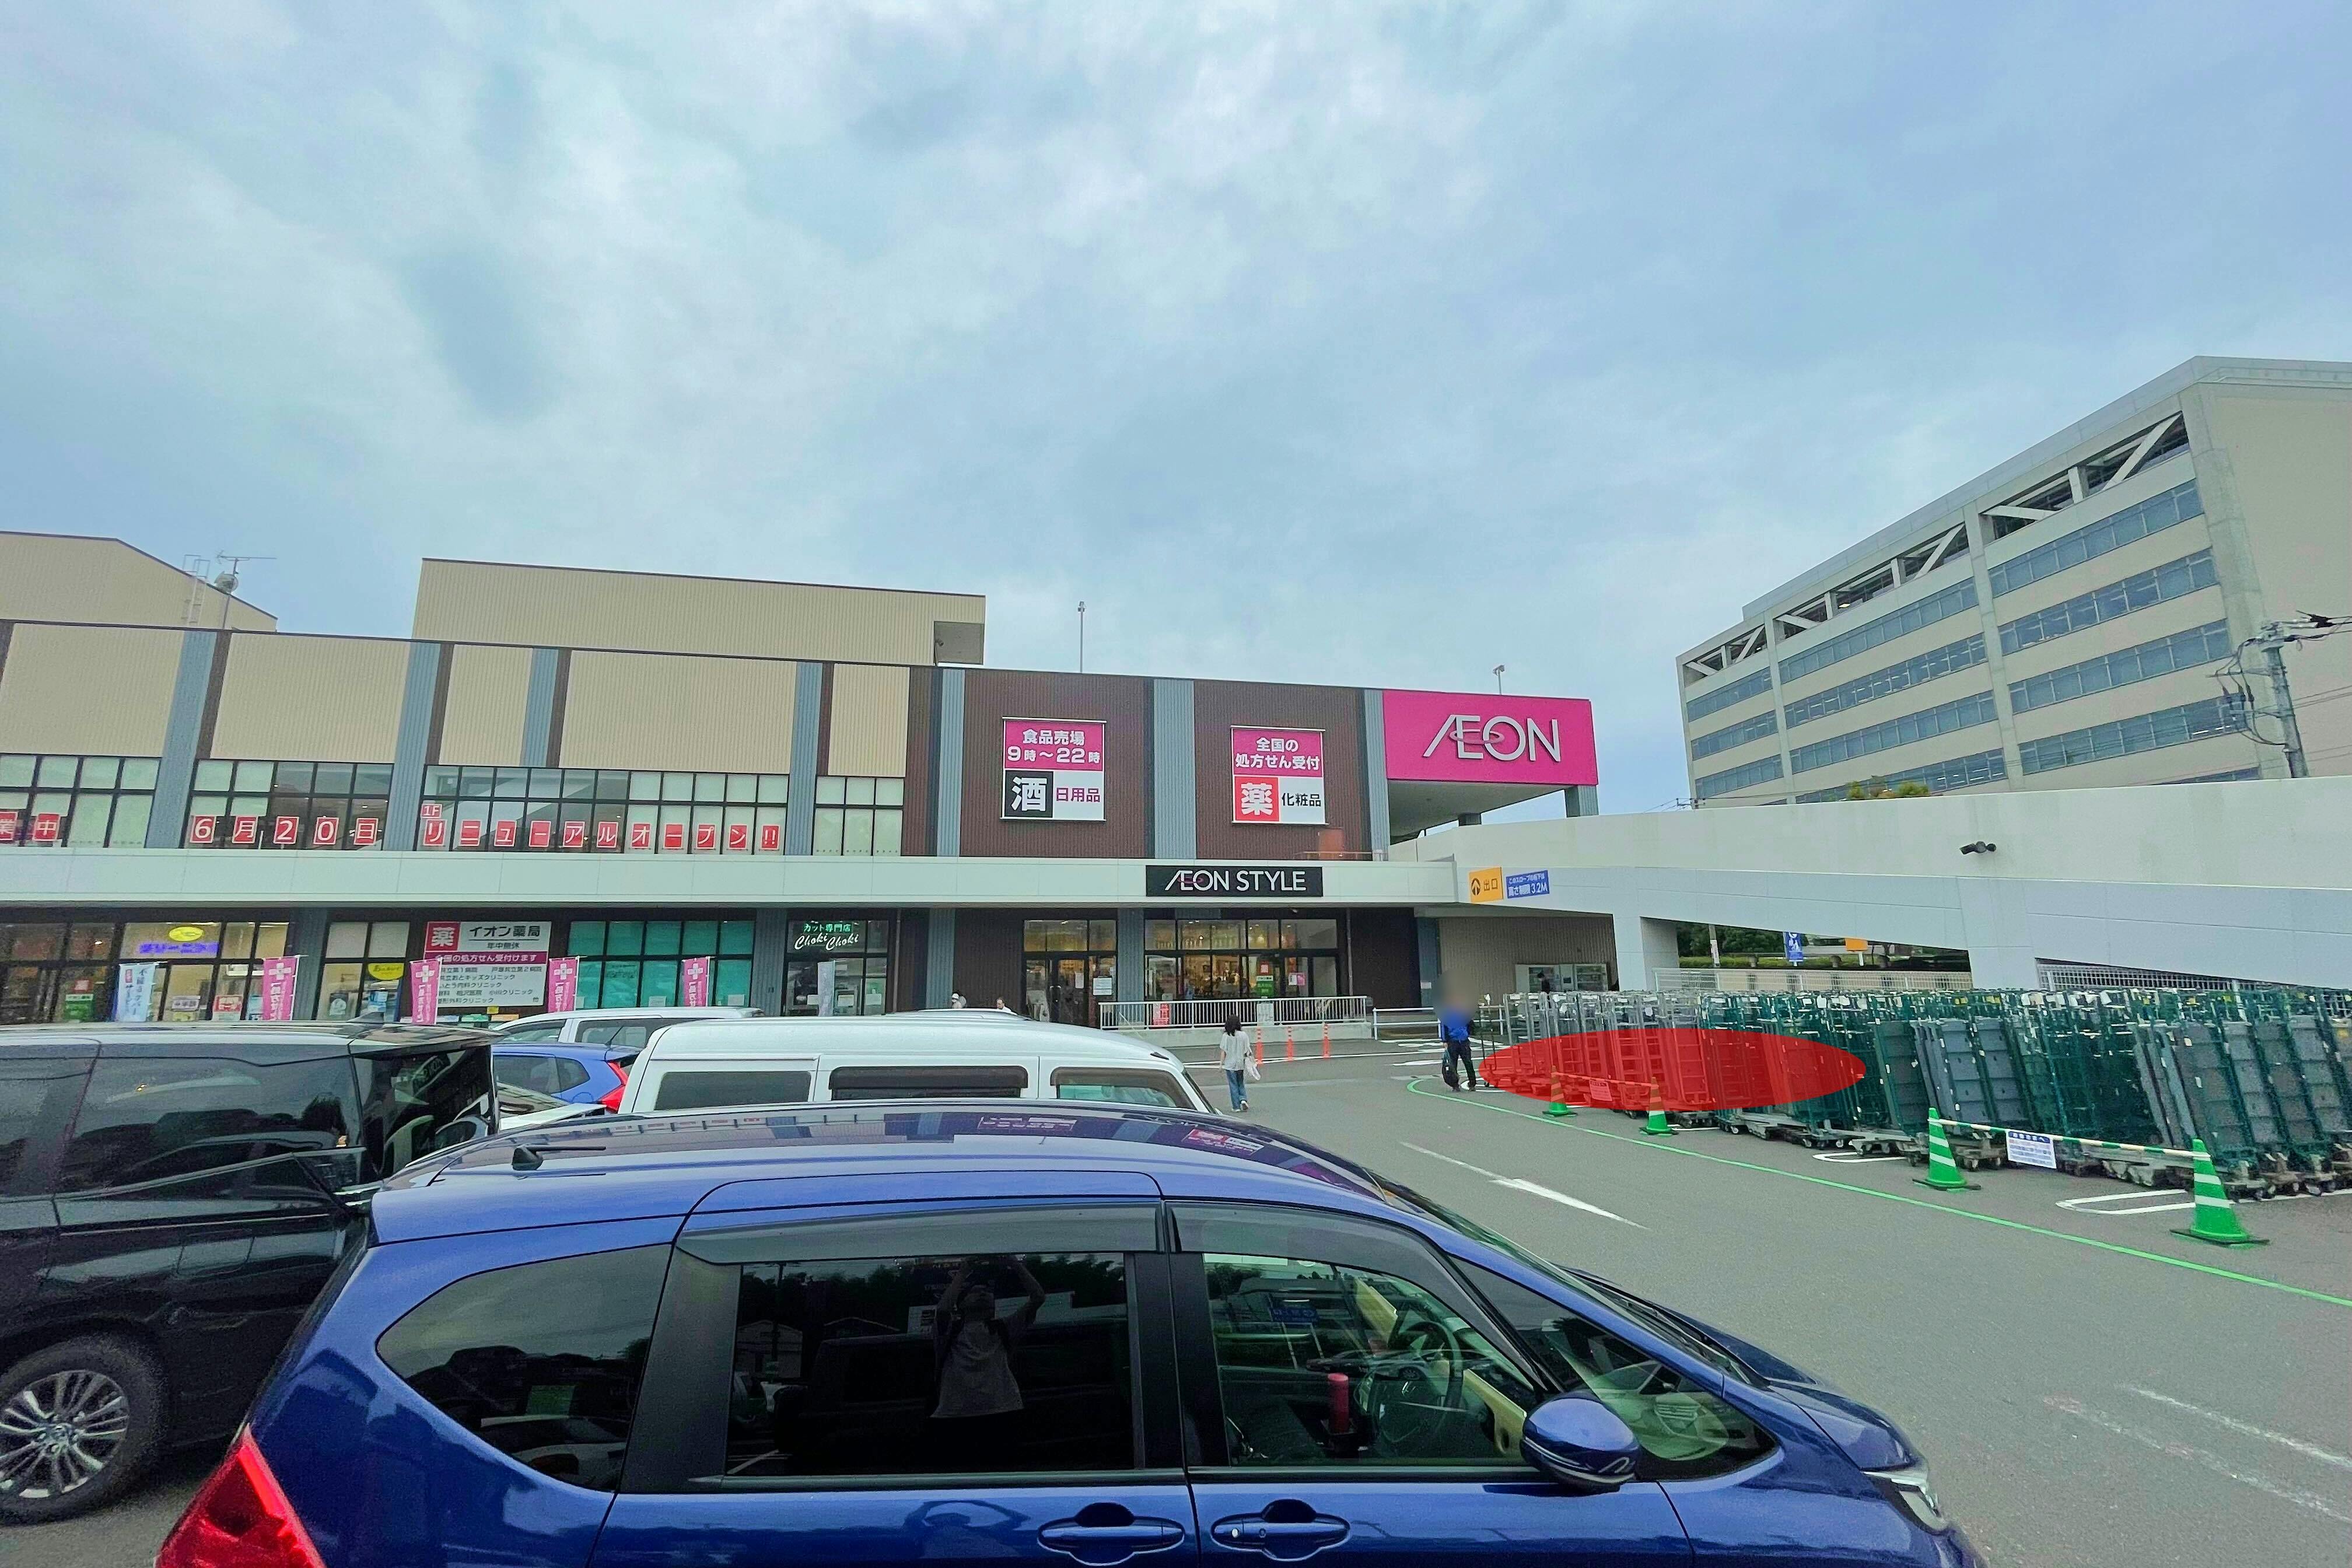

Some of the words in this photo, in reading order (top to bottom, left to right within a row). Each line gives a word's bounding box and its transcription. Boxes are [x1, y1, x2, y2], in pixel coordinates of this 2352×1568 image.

[1023, 729, 1085, 746] 食品売場
[1256, 737, 1299, 752] 全国の
[1235, 752, 1320, 771] 処方せん受付
[1011, 776, 1048, 811] 酒
[1056, 788, 1101, 803] 日用品
[1241, 782, 1273, 816] 薬
[1282, 793, 1321, 807] 化粧品
[424, 806, 440, 816] 1F
[1236, 870, 1307, 891] STYLE
[1483, 878, 1498, 891] 出口
[469, 925, 541, 937] イオン薬局
[803, 923, 851, 932] カット専門店
[431, 926, 455, 947] 薬
[794, 932, 828, 950] Choki
[825, 933, 859, 951] Choki
